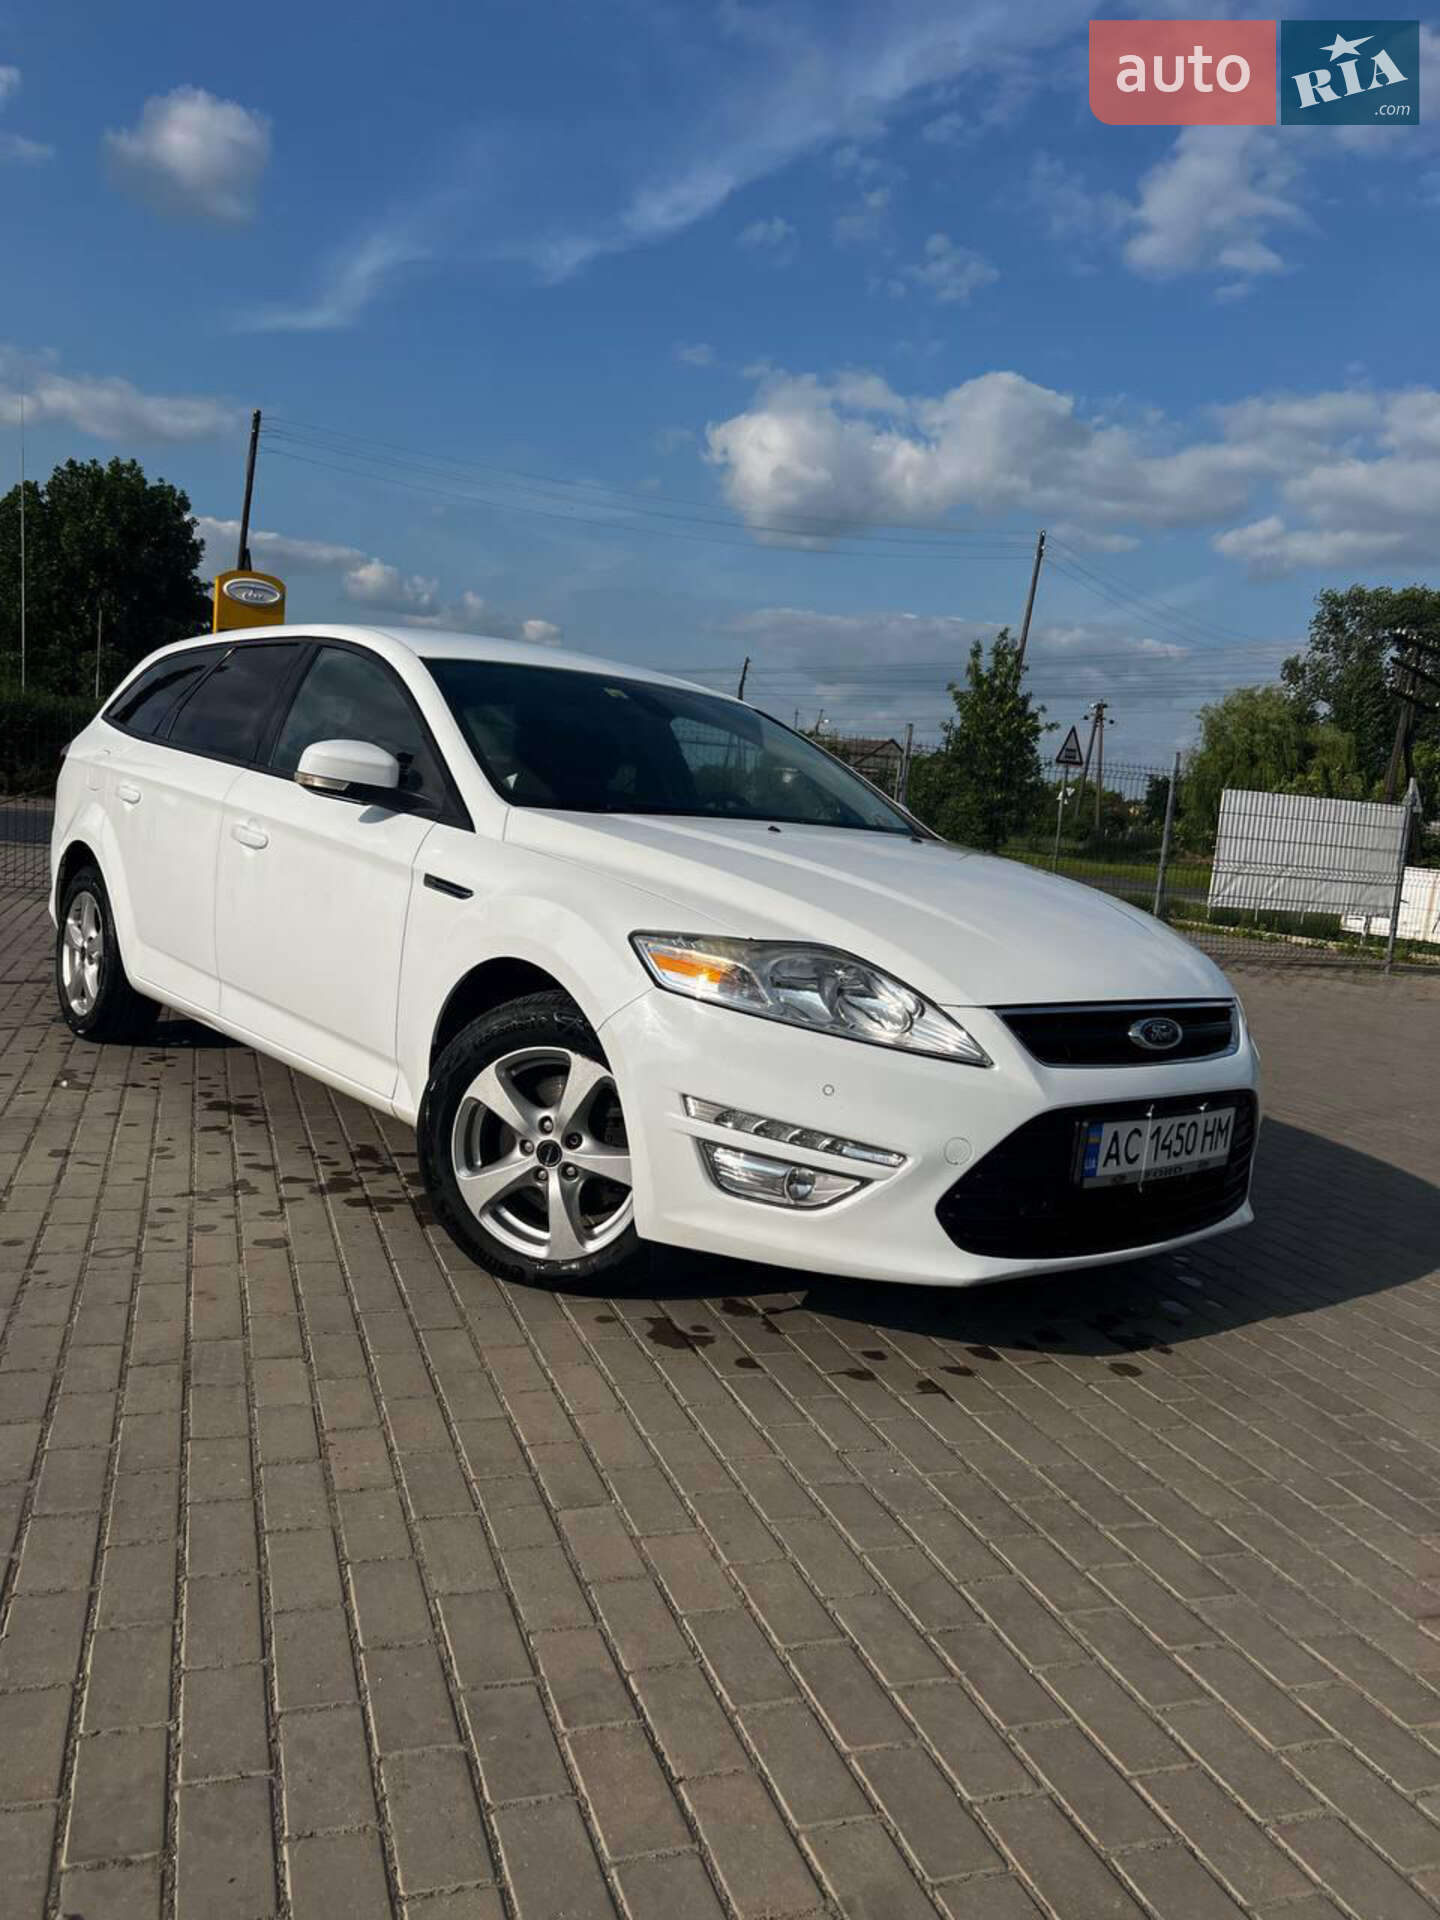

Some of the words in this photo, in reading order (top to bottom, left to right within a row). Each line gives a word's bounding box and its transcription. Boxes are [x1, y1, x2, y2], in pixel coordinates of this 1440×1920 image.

[1102, 1127, 1142, 1168] AC
[1150, 1121, 1198, 1162] 1450
[1200, 1115, 1232, 1153] HM
